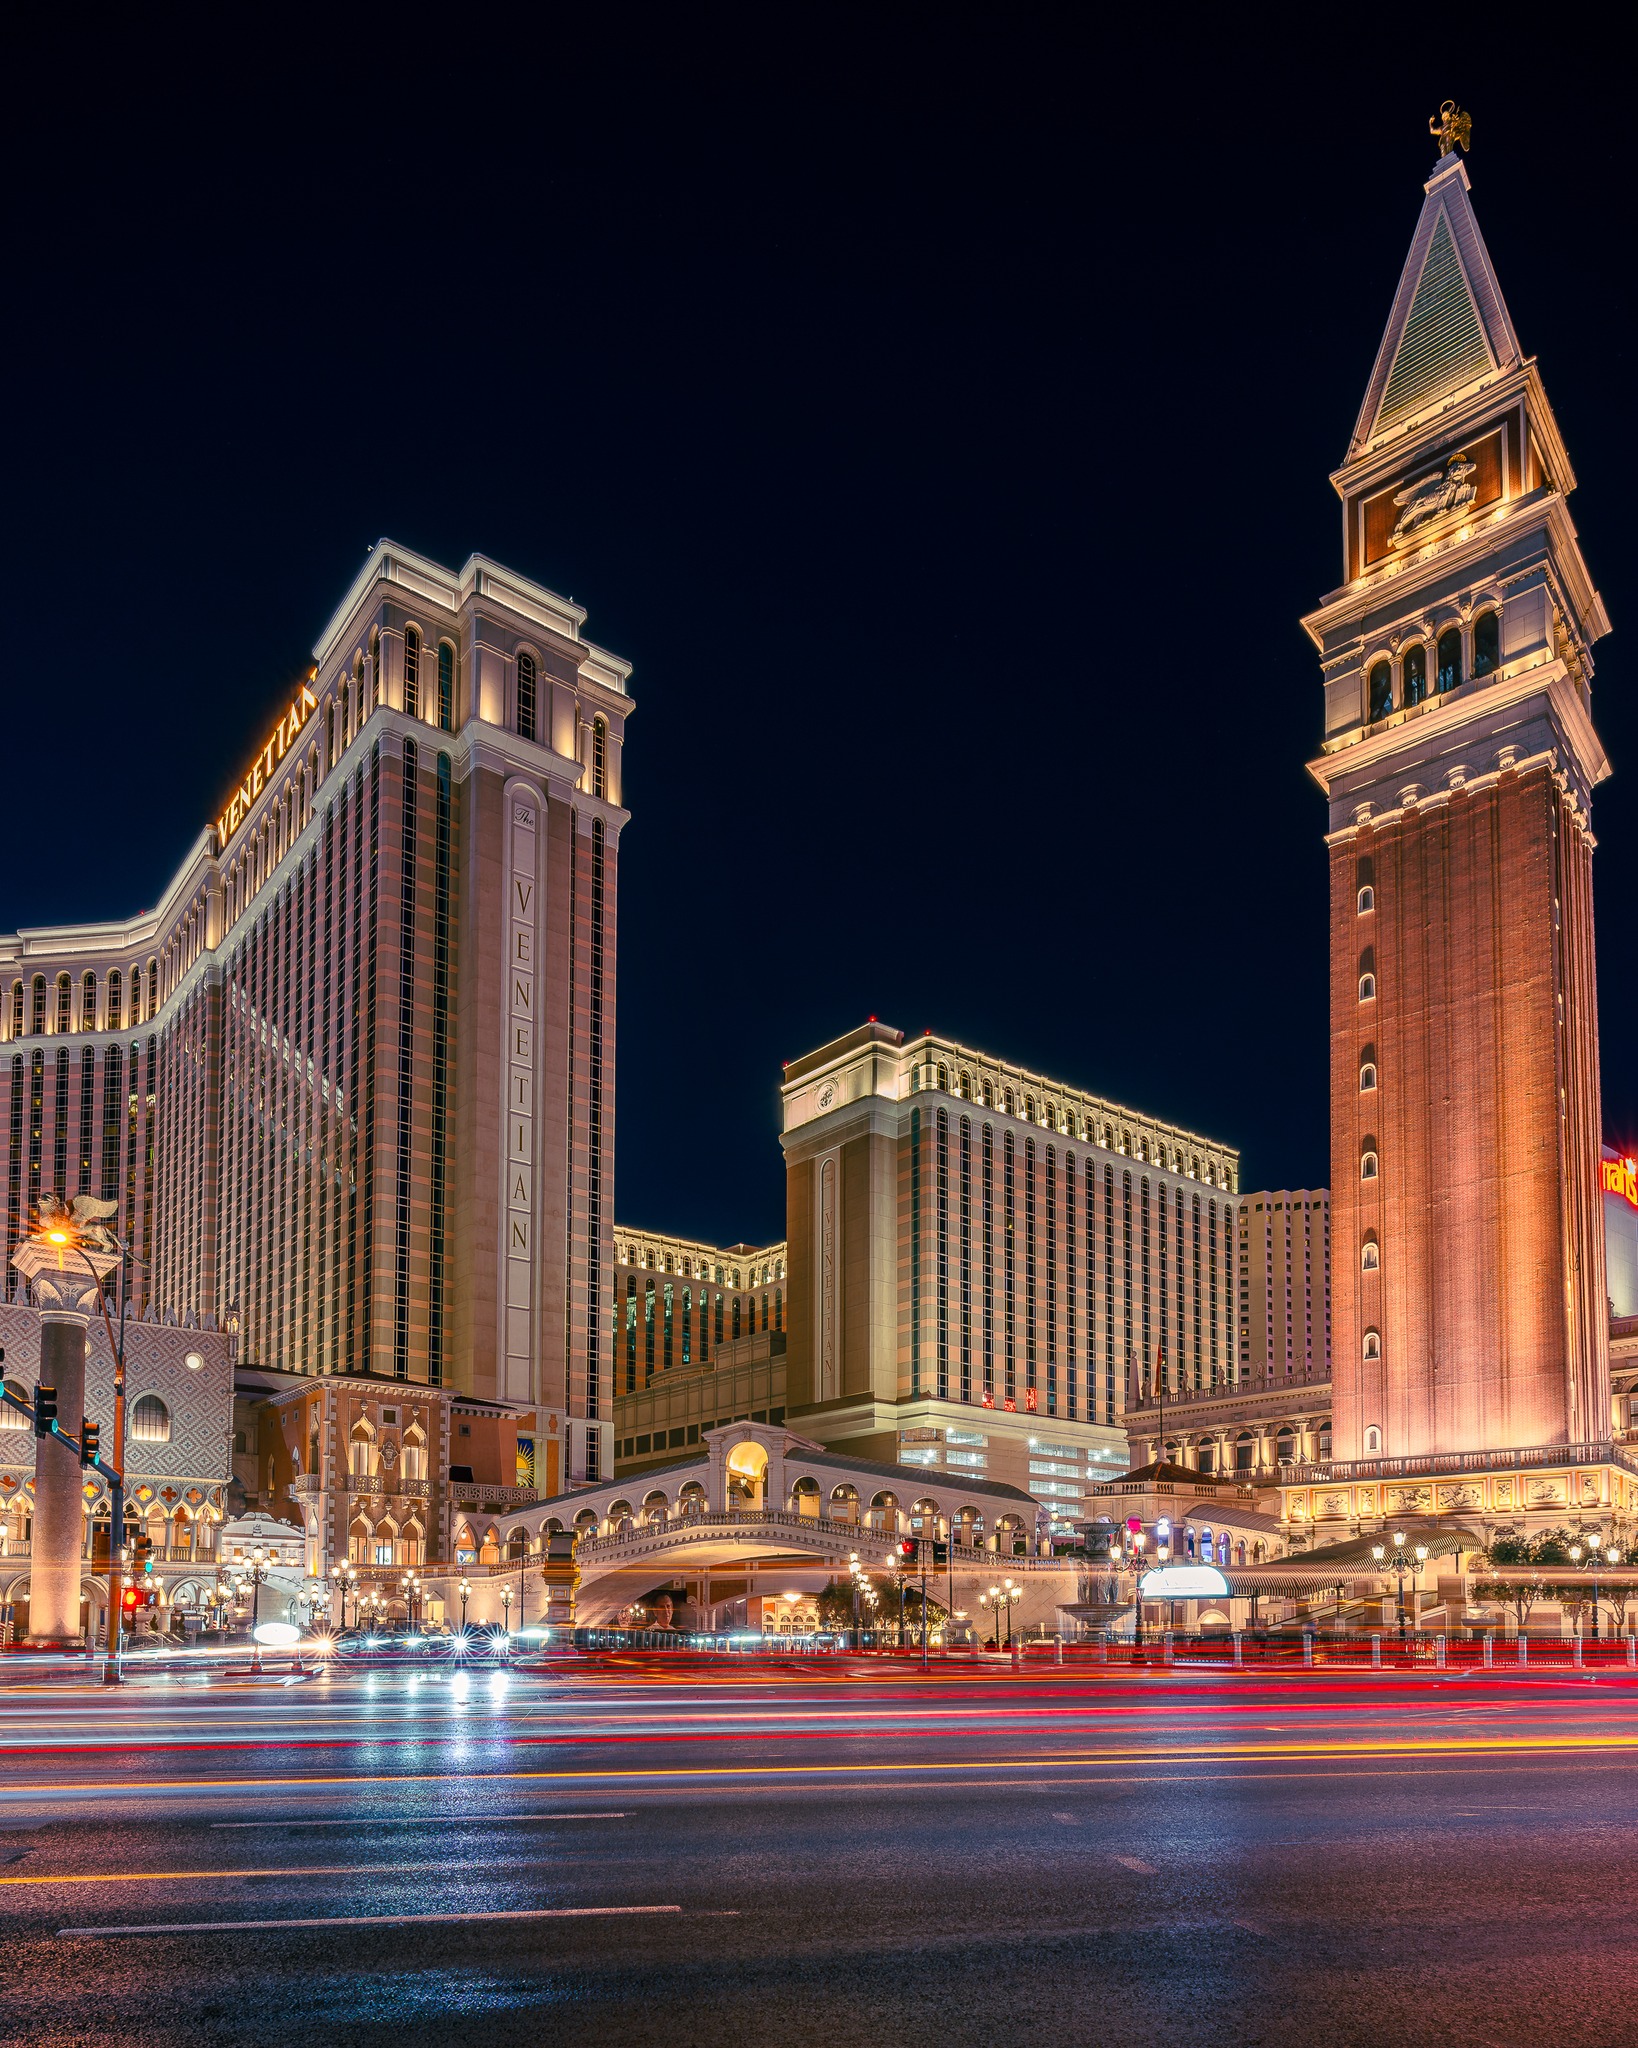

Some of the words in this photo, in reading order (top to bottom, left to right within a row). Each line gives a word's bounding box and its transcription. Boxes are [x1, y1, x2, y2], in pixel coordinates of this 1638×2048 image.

[217, 667, 317, 847] VENETIAN
[514, 807, 534, 826] The
[511, 879, 533, 1250] VENETIAN
[825, 1210, 833, 1374] VENETIAN
